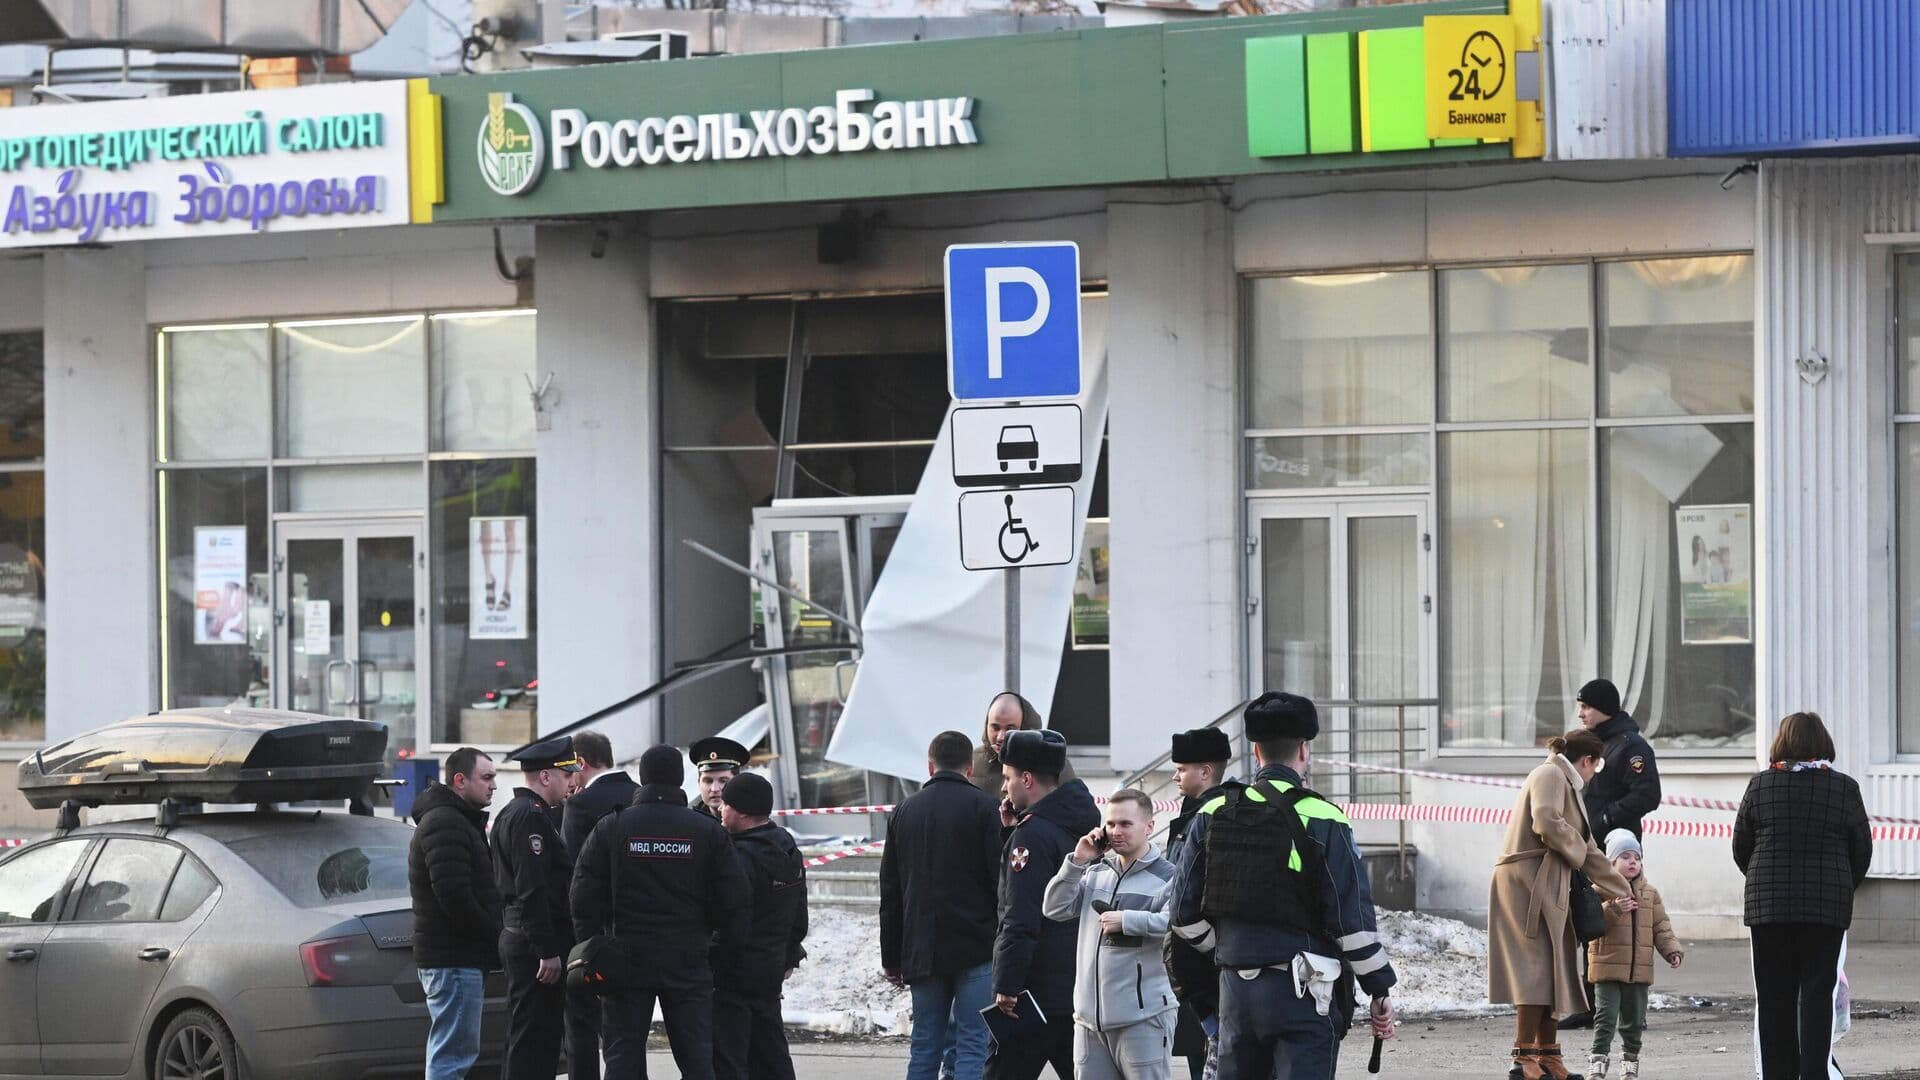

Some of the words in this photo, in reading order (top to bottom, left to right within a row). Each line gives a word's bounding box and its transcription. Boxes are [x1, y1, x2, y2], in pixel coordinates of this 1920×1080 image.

[1448, 69, 1481, 100] 24
[276, 112, 384, 153] САЛОН
[550, 88, 978, 171] РоссельхозБанк
[1448, 109, 1507, 125] Банкомат
[3, 169, 156, 243] Азбука
[174, 161, 385, 231] Здоровья
[984, 266, 1052, 379] P
[629, 842, 650, 854] МВД
[653, 843, 691, 854] РОССИИ
